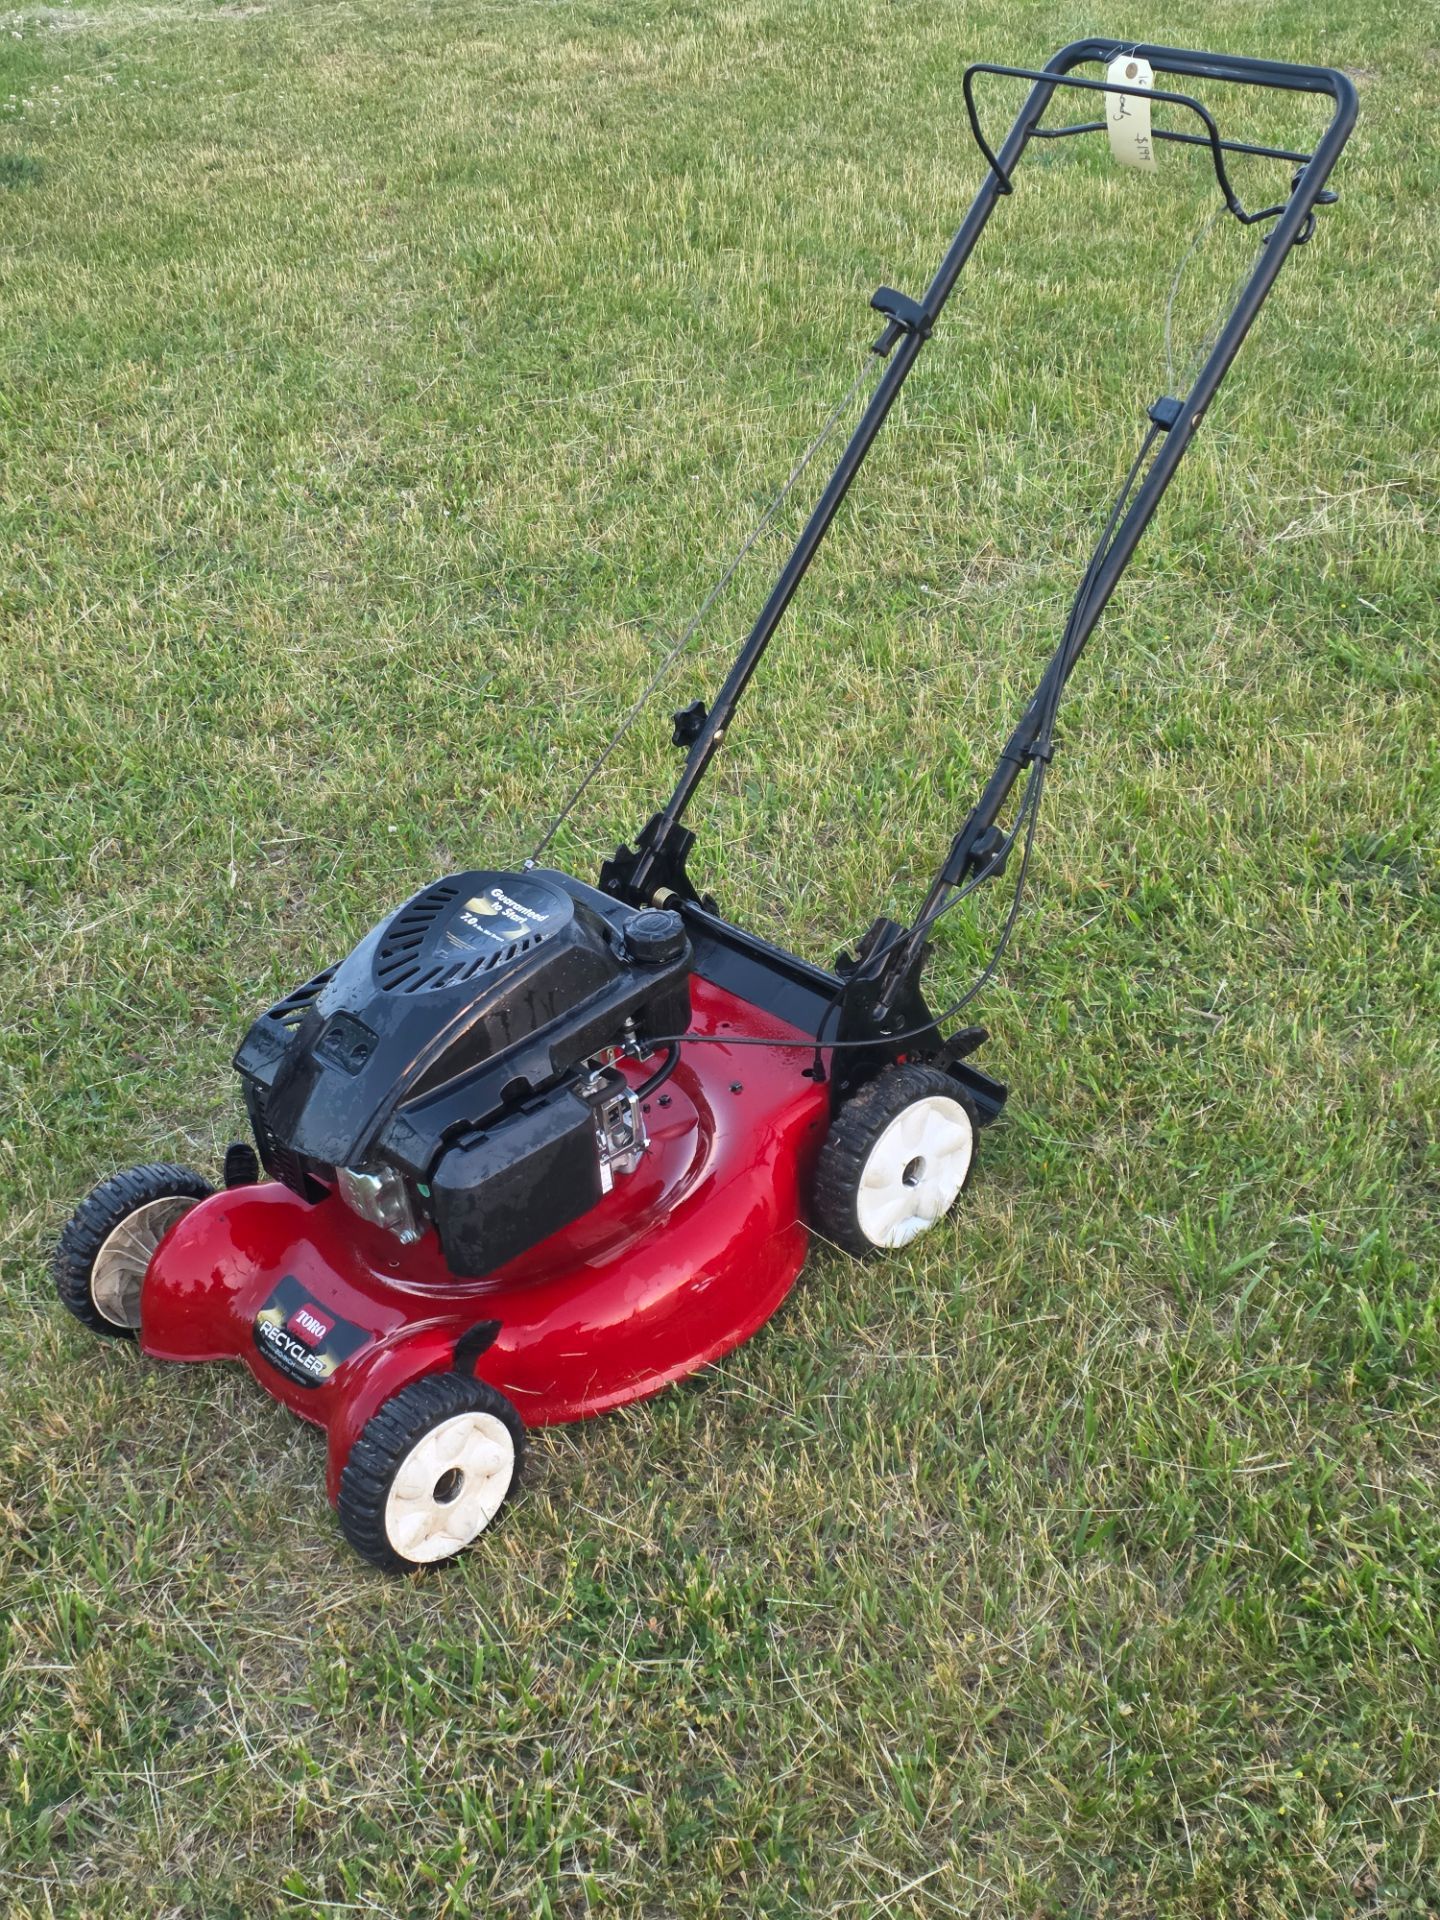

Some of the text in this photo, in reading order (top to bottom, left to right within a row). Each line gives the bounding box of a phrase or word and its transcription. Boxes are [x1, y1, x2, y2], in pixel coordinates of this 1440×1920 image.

[460, 912, 479, 925] 7.0
[490, 888, 550, 922] Guaranteed
[491, 901, 528, 924] to Start
[295, 1309, 327, 1338] TORO
[260, 1320, 324, 1376] RECYCLER
